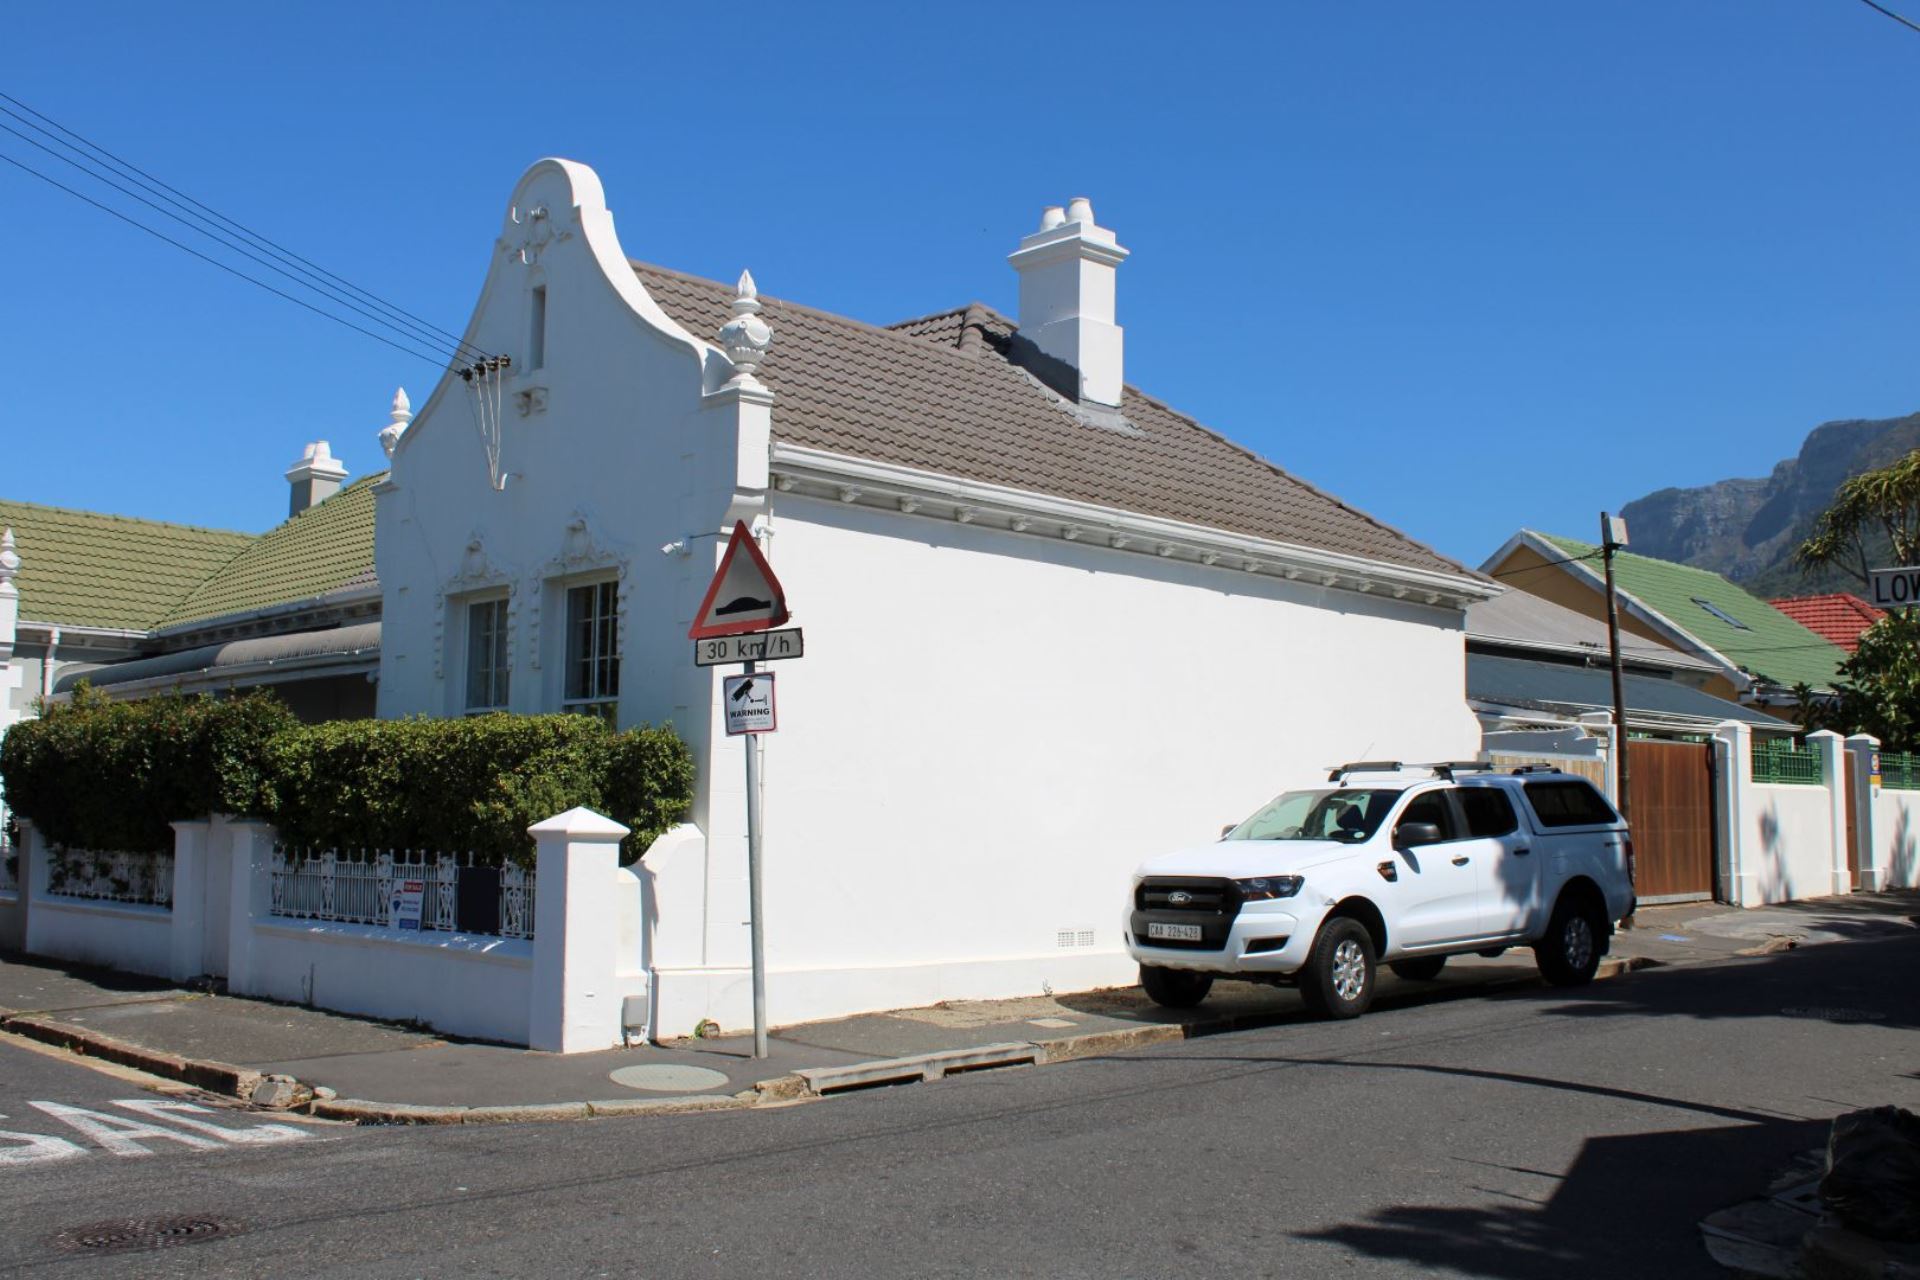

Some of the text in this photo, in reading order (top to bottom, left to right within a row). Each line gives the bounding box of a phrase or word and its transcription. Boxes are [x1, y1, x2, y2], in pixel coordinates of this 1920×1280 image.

[707, 636, 790, 659] 30 km/h
[729, 708, 770, 718] WARNING
